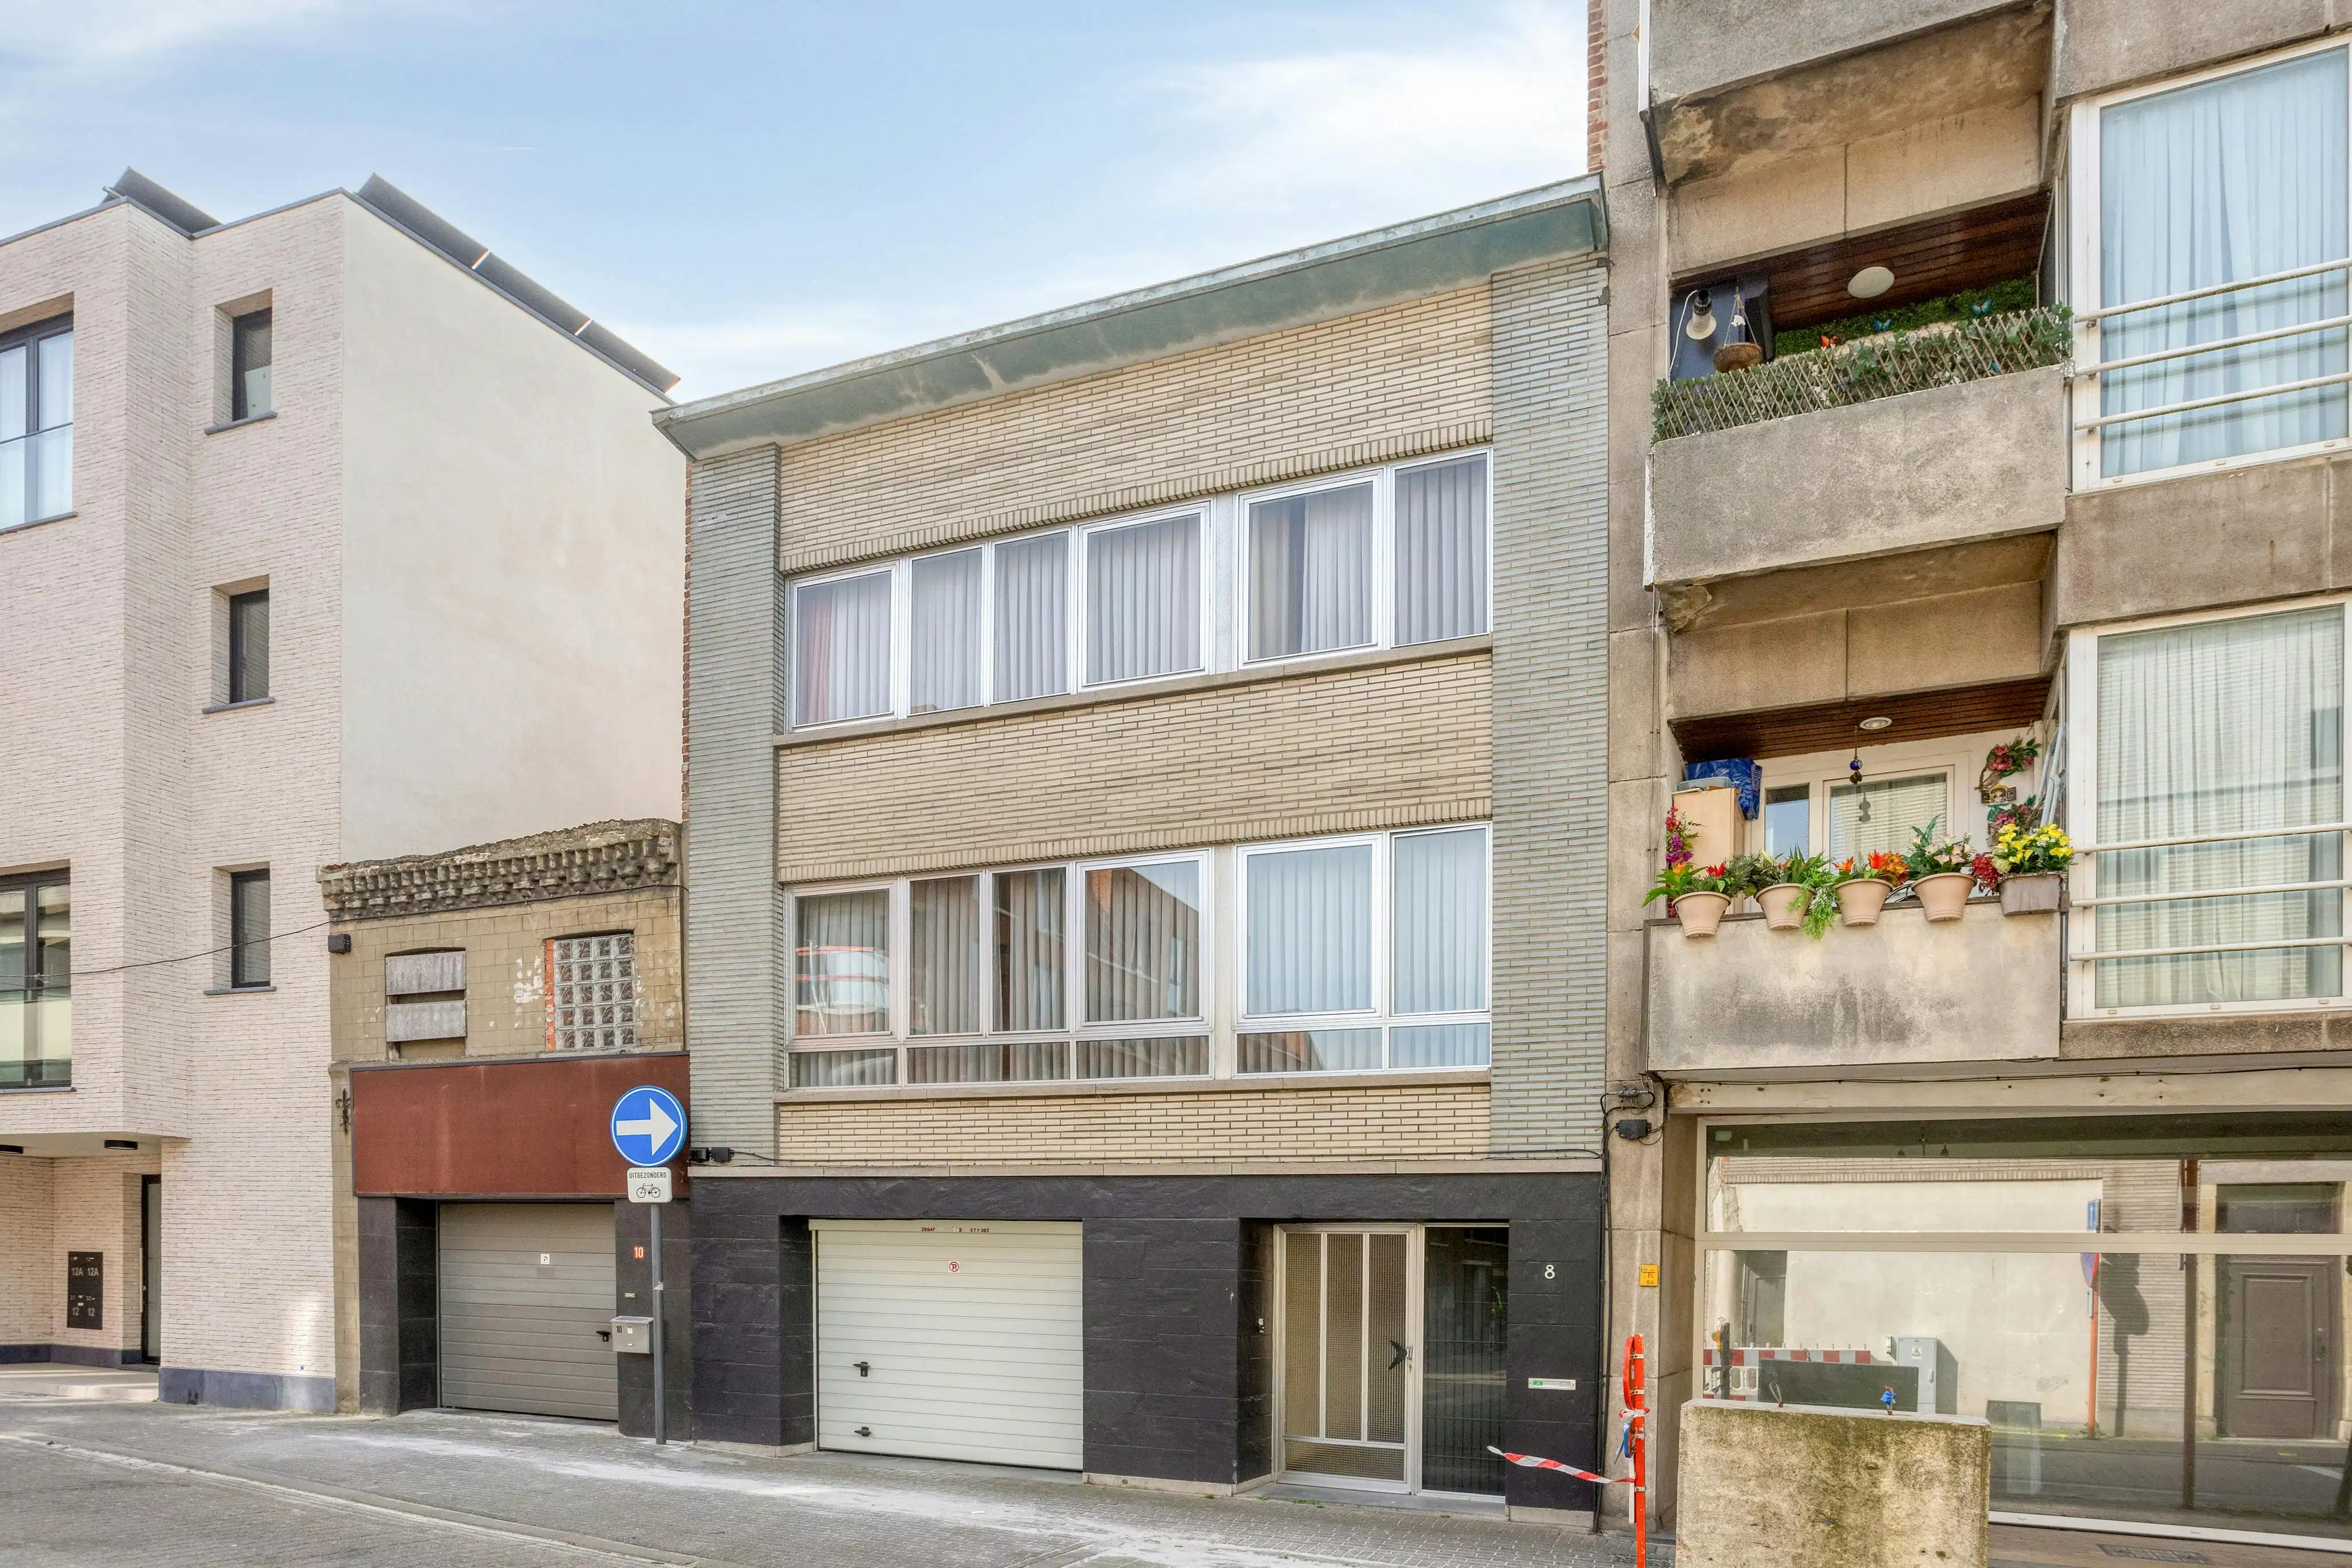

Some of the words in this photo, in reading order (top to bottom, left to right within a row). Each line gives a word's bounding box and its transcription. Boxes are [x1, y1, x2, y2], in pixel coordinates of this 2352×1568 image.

[634, 1246, 644, 1257] 10
[72, 1267, 84, 1276] 12A
[88, 1267, 99, 1276] 12A
[1545, 1265, 1555, 1279] 8
[72, 1307, 80, 1316] 12
[88, 1307, 95, 1316] 12
